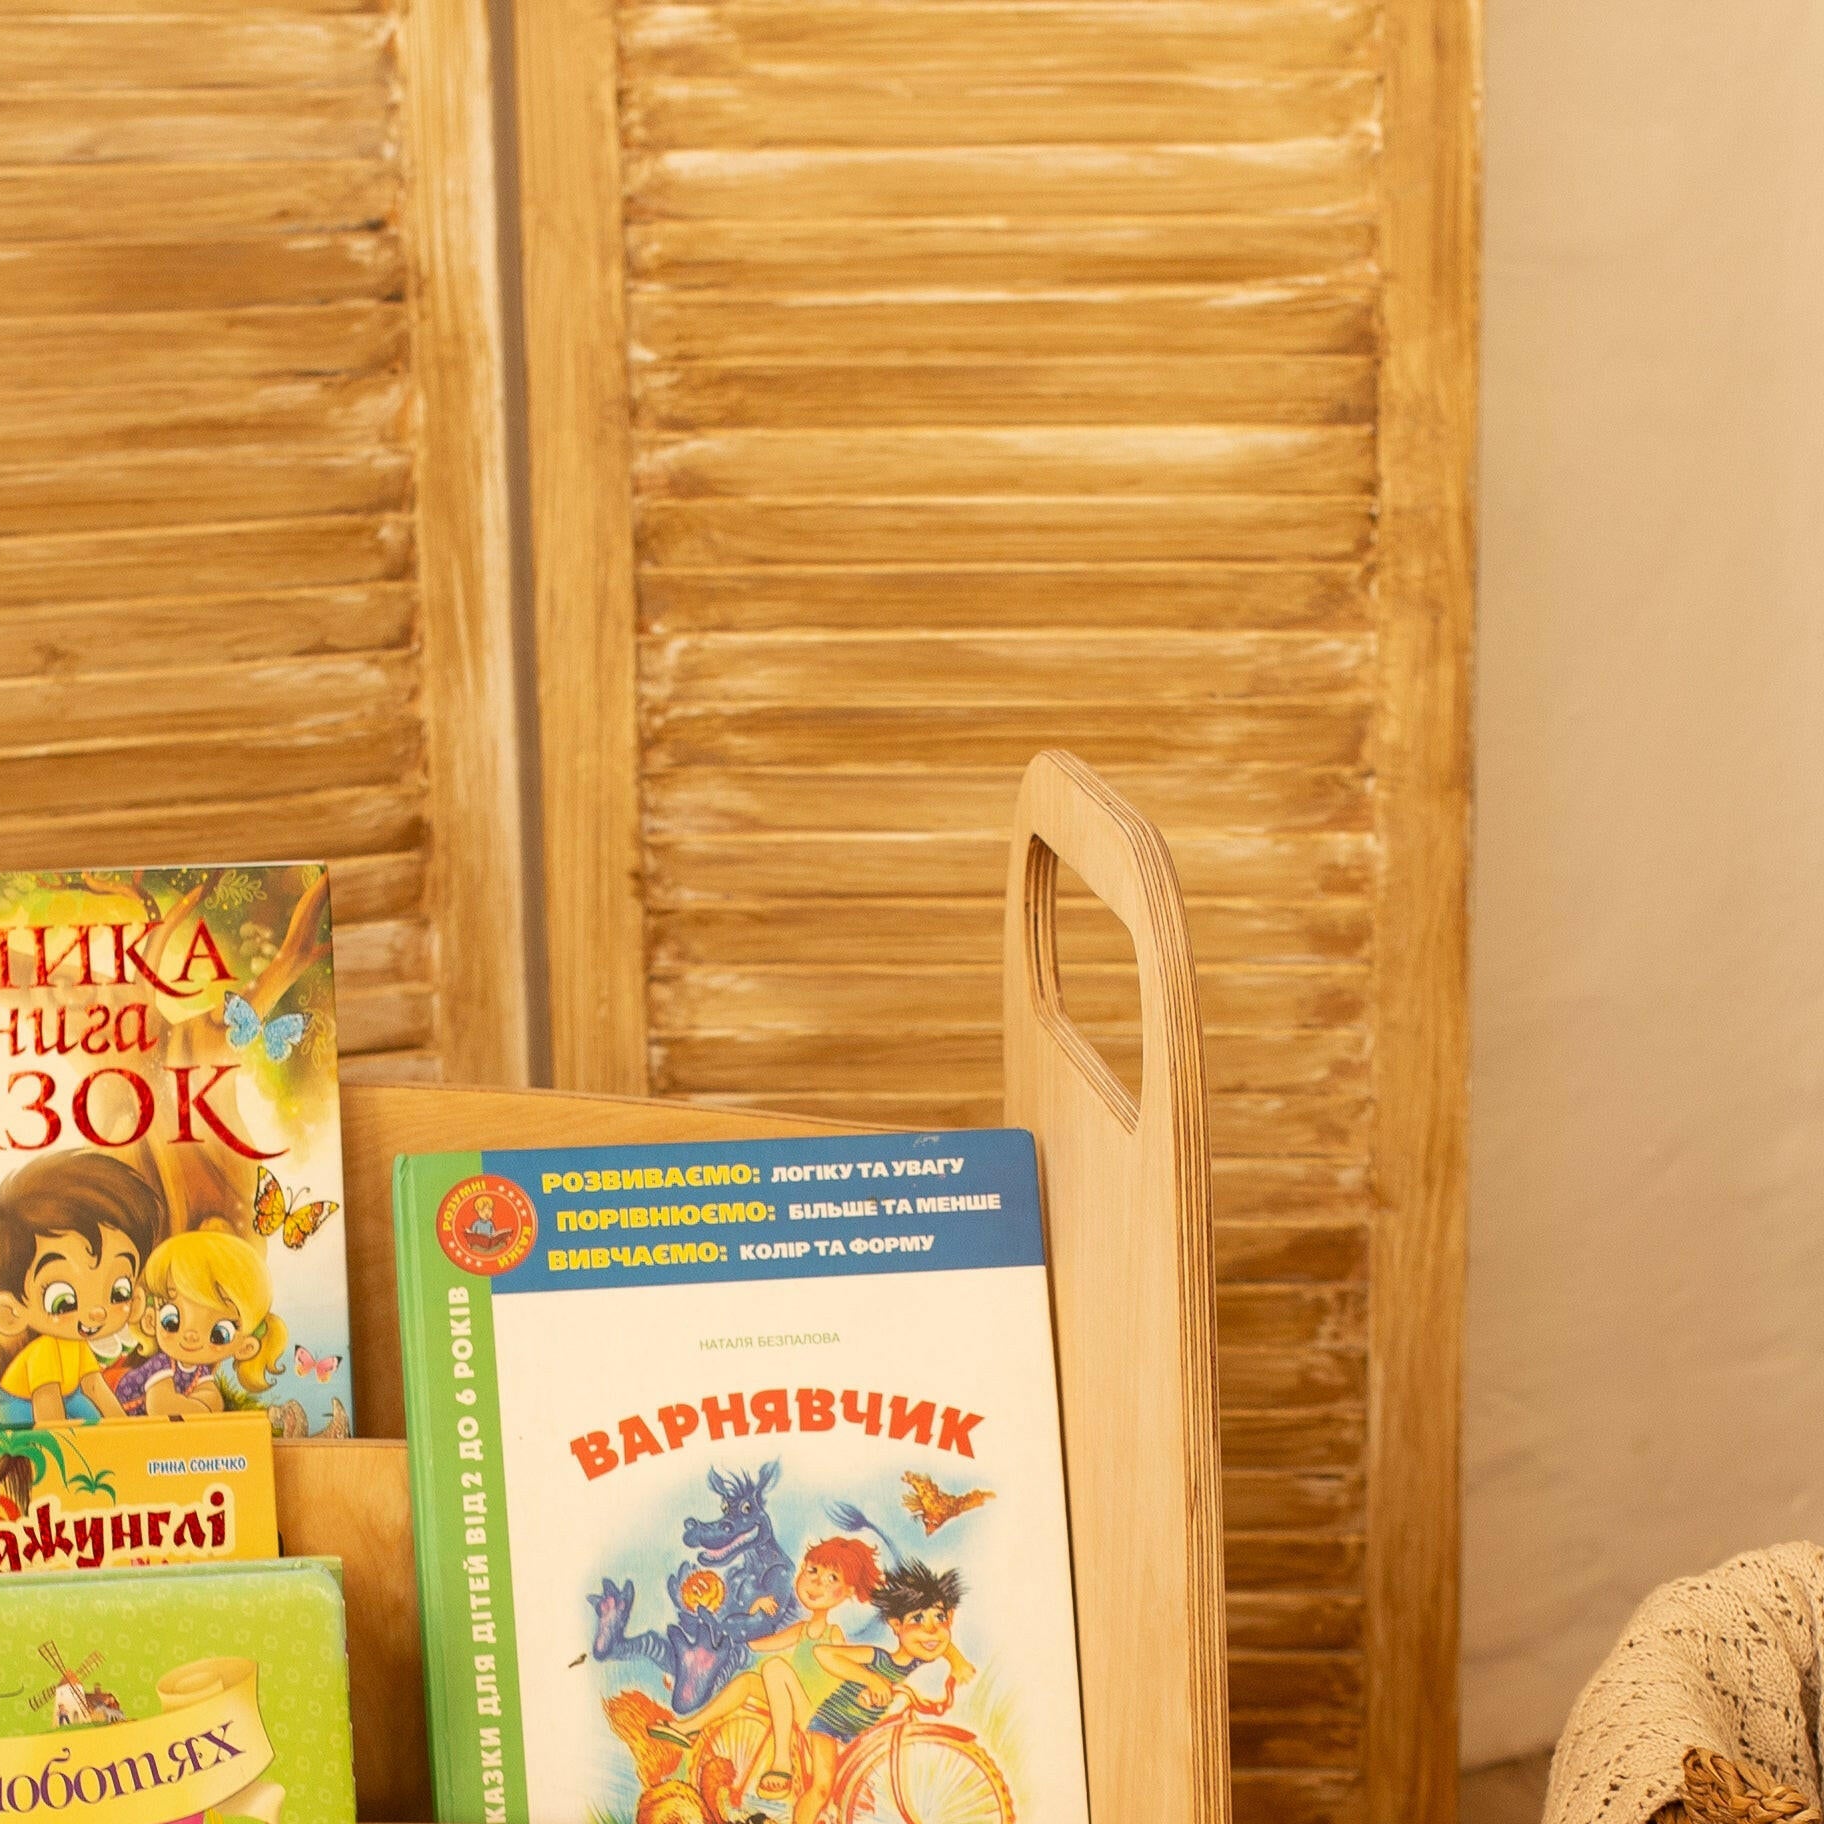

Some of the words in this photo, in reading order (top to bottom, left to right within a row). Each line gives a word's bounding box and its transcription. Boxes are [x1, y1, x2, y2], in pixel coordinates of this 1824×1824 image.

[541, 1164, 761, 1194] РОЗВИВАЄМО:
[771, 1163, 854, 1183] ЛОГІКУ
[857, 1162, 889, 1179] ТА
[891, 1158, 964, 1178] УВАГУ
[556, 1201, 776, 1232] ПОРІВНЮЄМО:
[788, 1200, 878, 1220] БІЛЬШЕ
[881, 1198, 913, 1215] ТА
[916, 1193, 1002, 1214] МЕНШЕ
[547, 1241, 728, 1271] ВИВЧАЄМО:
[740, 1240, 811, 1261] КОЛІР
[814, 1239, 846, 1256] ТА
[849, 1235, 935, 1255] ФОРМУ
[448, 1286, 474, 1379] РОКІВ
[699, 1336, 753, 1351] НАТАЛЯ
[758, 1332, 840, 1348] БЕЗПАЛОВА
[455, 1388, 477, 1405] 6
[457, 1416, 483, 1461] ДО
[570, 1388, 985, 1481] ВАРНЯВЧИК
[148, 1460, 186, 1475] ІРИНА
[460, 1471, 483, 1489] 2
[463, 1492, 487, 1545] ВІД
[463, 1555, 496, 1643] ДІТЕЙ
[474, 1655, 501, 1716] ДЛЯ
[479, 1727, 506, 1824] КАЗКИ
